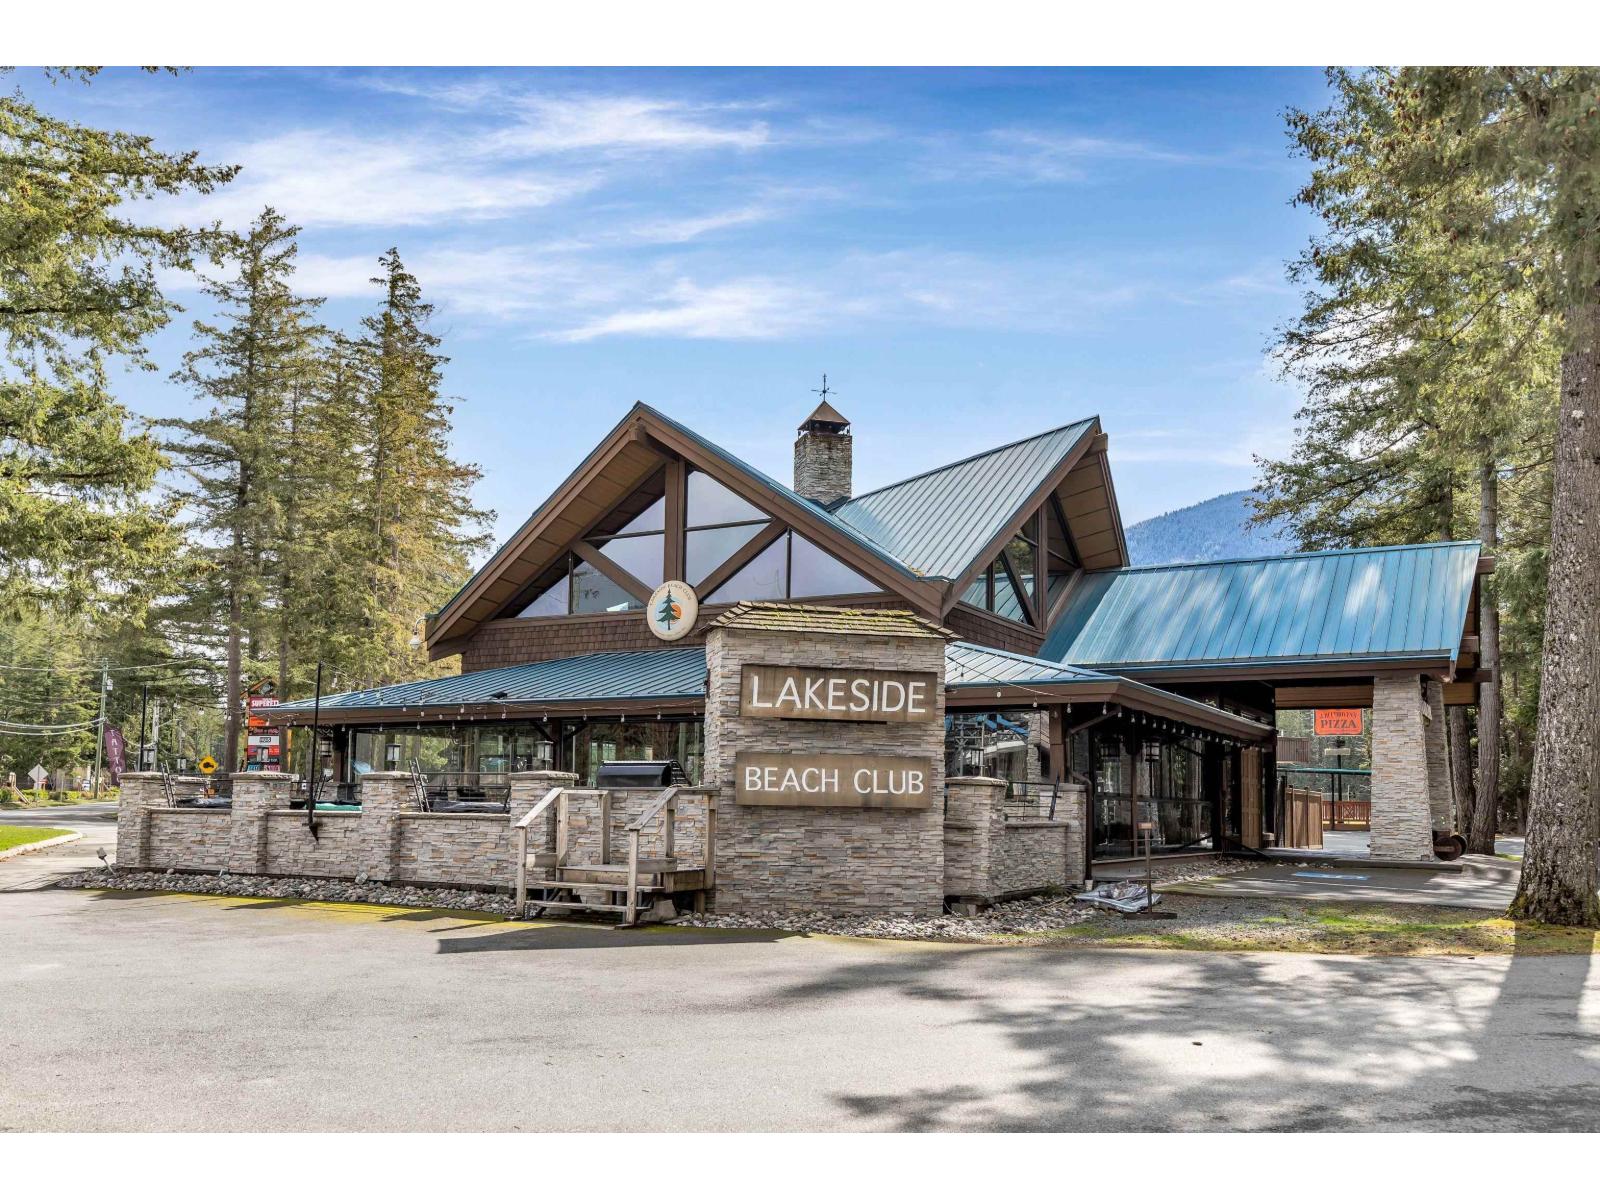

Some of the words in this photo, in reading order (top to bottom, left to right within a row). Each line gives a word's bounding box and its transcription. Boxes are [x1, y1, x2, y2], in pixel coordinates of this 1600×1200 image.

[752, 675, 926, 713] LAKESIDE
[1320, 719, 1357, 729] PIZZA
[745, 766, 839, 793] BEACH
[853, 768, 924, 795] CLUB
